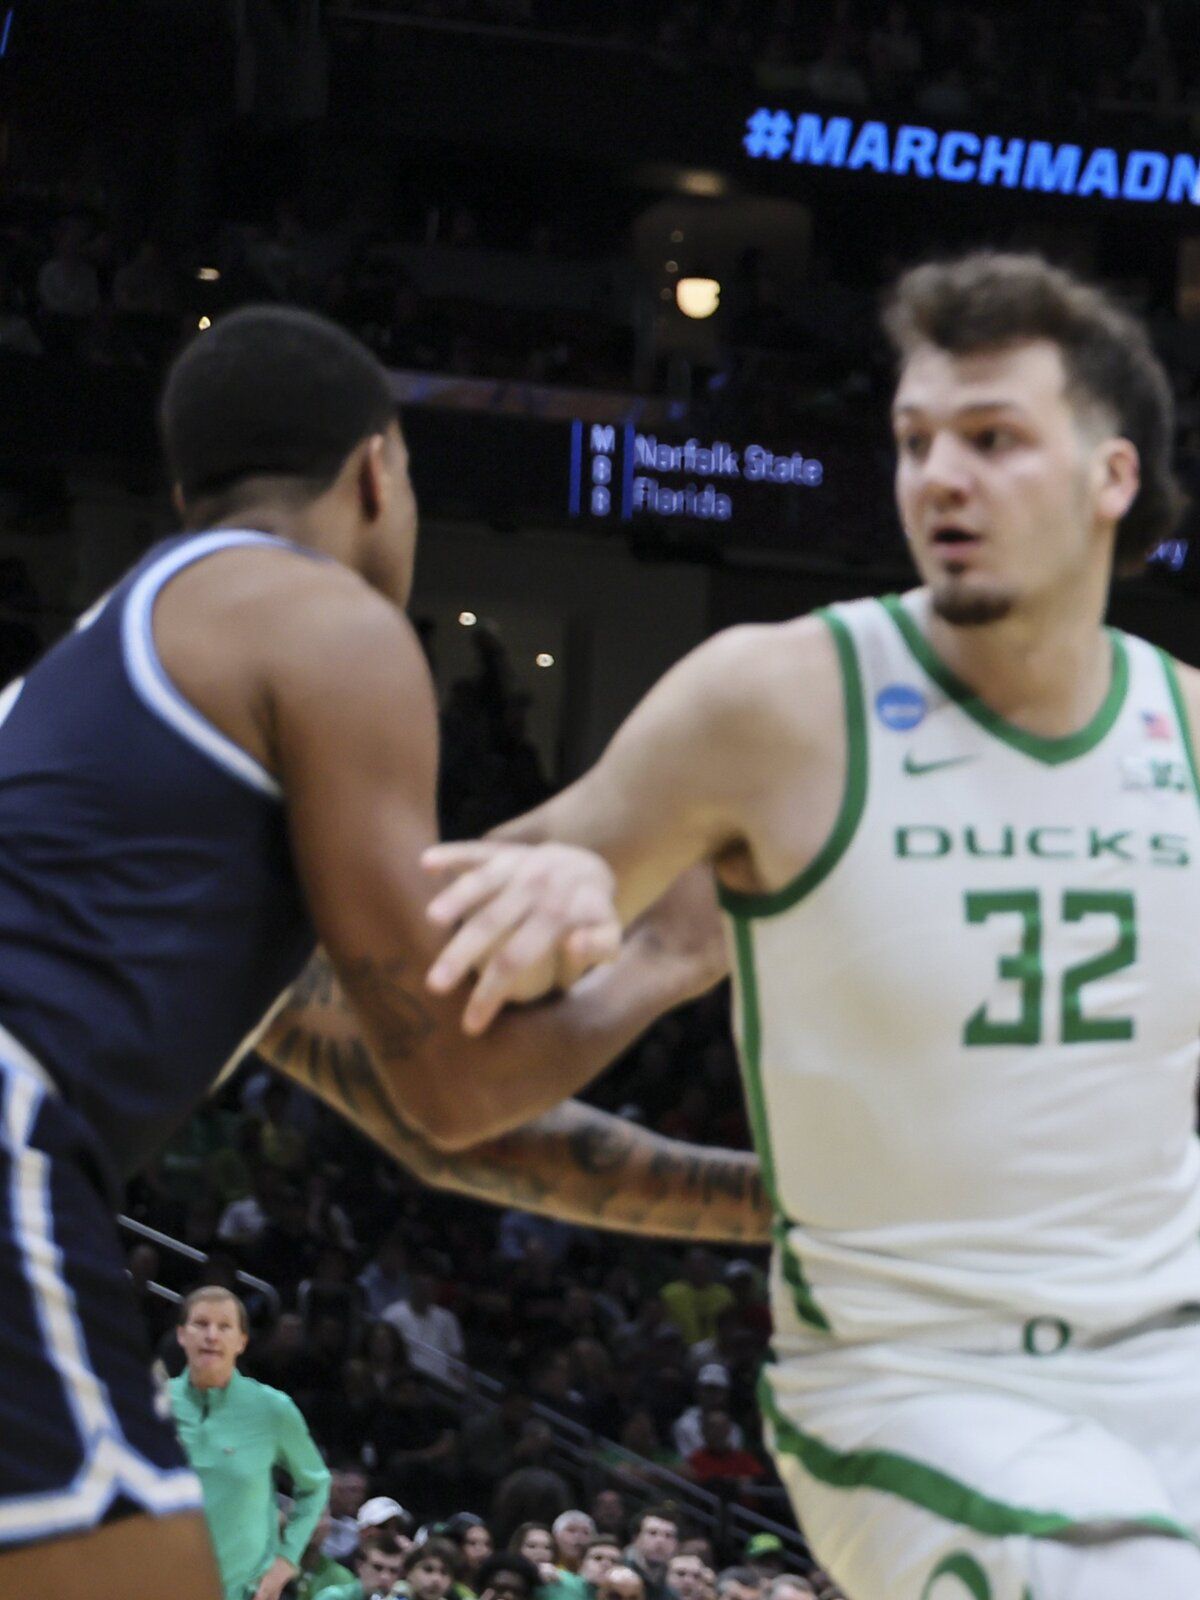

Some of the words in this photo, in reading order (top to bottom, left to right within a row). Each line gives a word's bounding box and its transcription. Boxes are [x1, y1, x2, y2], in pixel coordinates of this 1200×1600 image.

[634, 434, 739, 477] Norfolk
[744, 444, 823, 487] State
[633, 476, 732, 520] Florida
[894, 824, 1191, 867] DUCKS
[962, 887, 1138, 1048] 32
[1023, 1317, 1071, 1356] O
